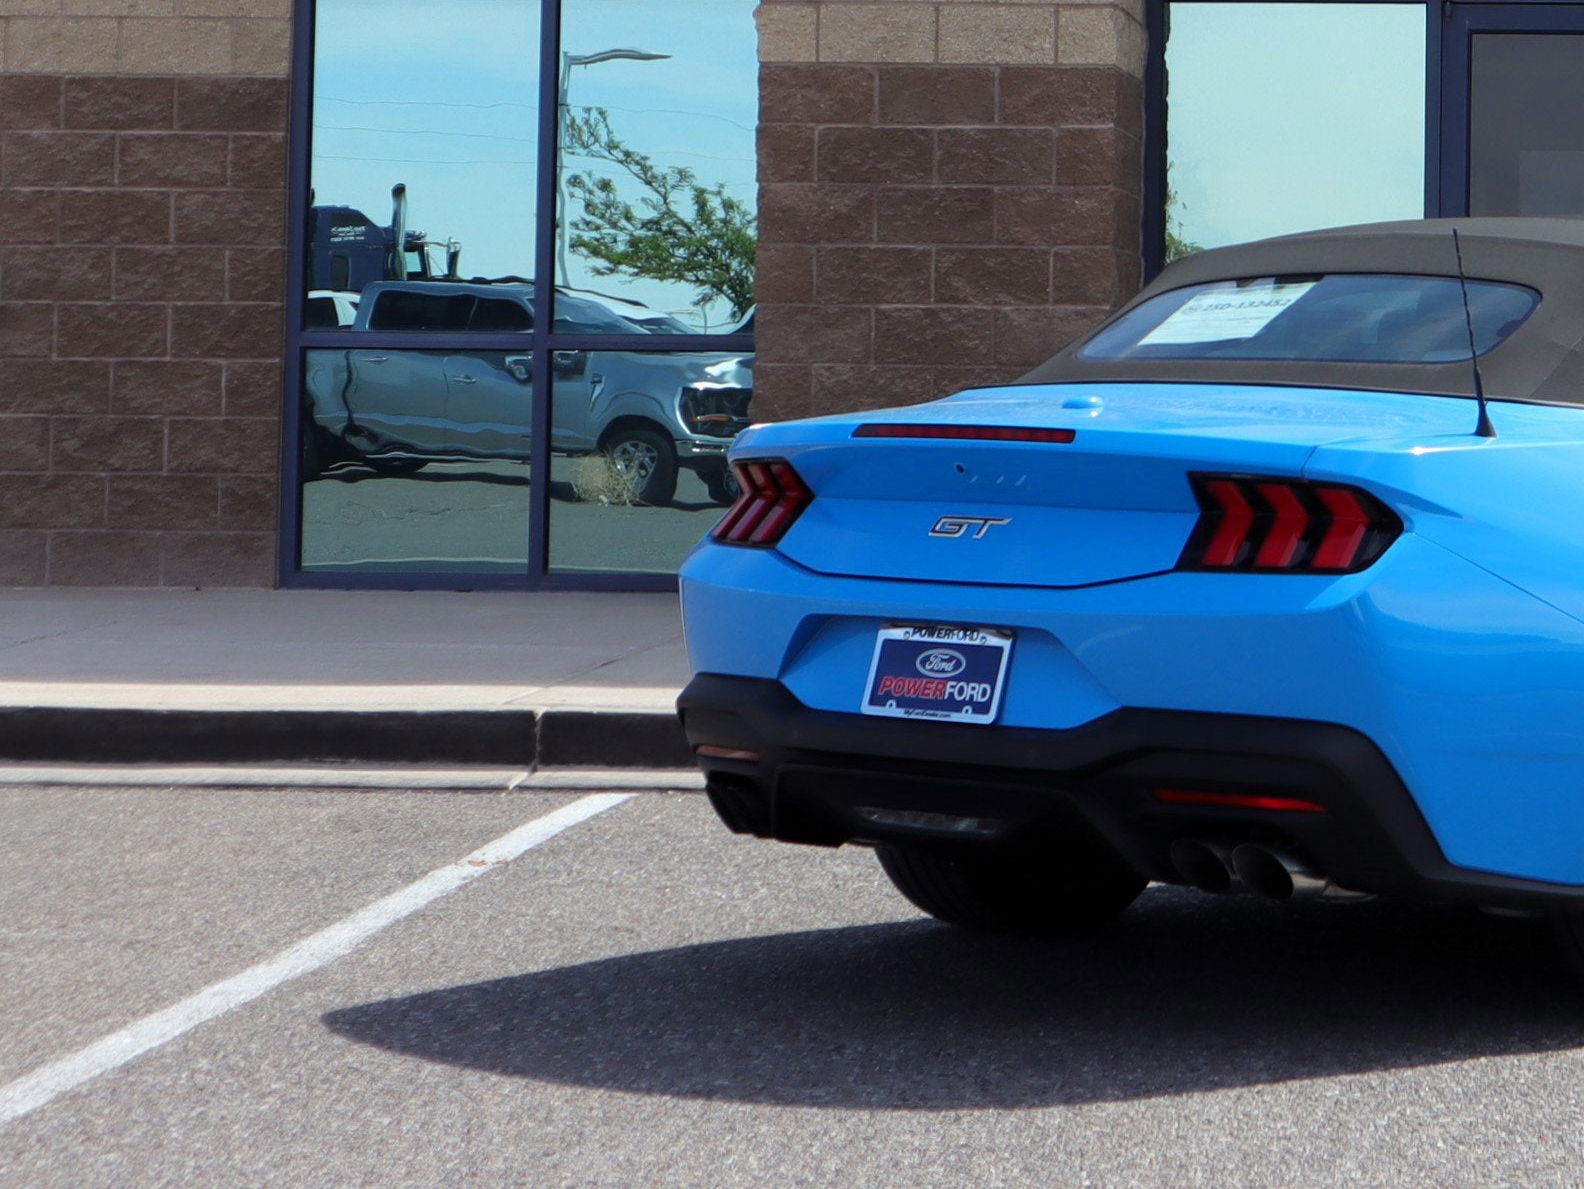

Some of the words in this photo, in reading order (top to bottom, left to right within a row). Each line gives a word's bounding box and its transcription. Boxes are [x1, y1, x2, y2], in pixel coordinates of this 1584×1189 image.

[928, 516, 1013, 539] GT
[924, 653, 957, 672] Ford
[878, 675, 991, 703] POWERFORD
